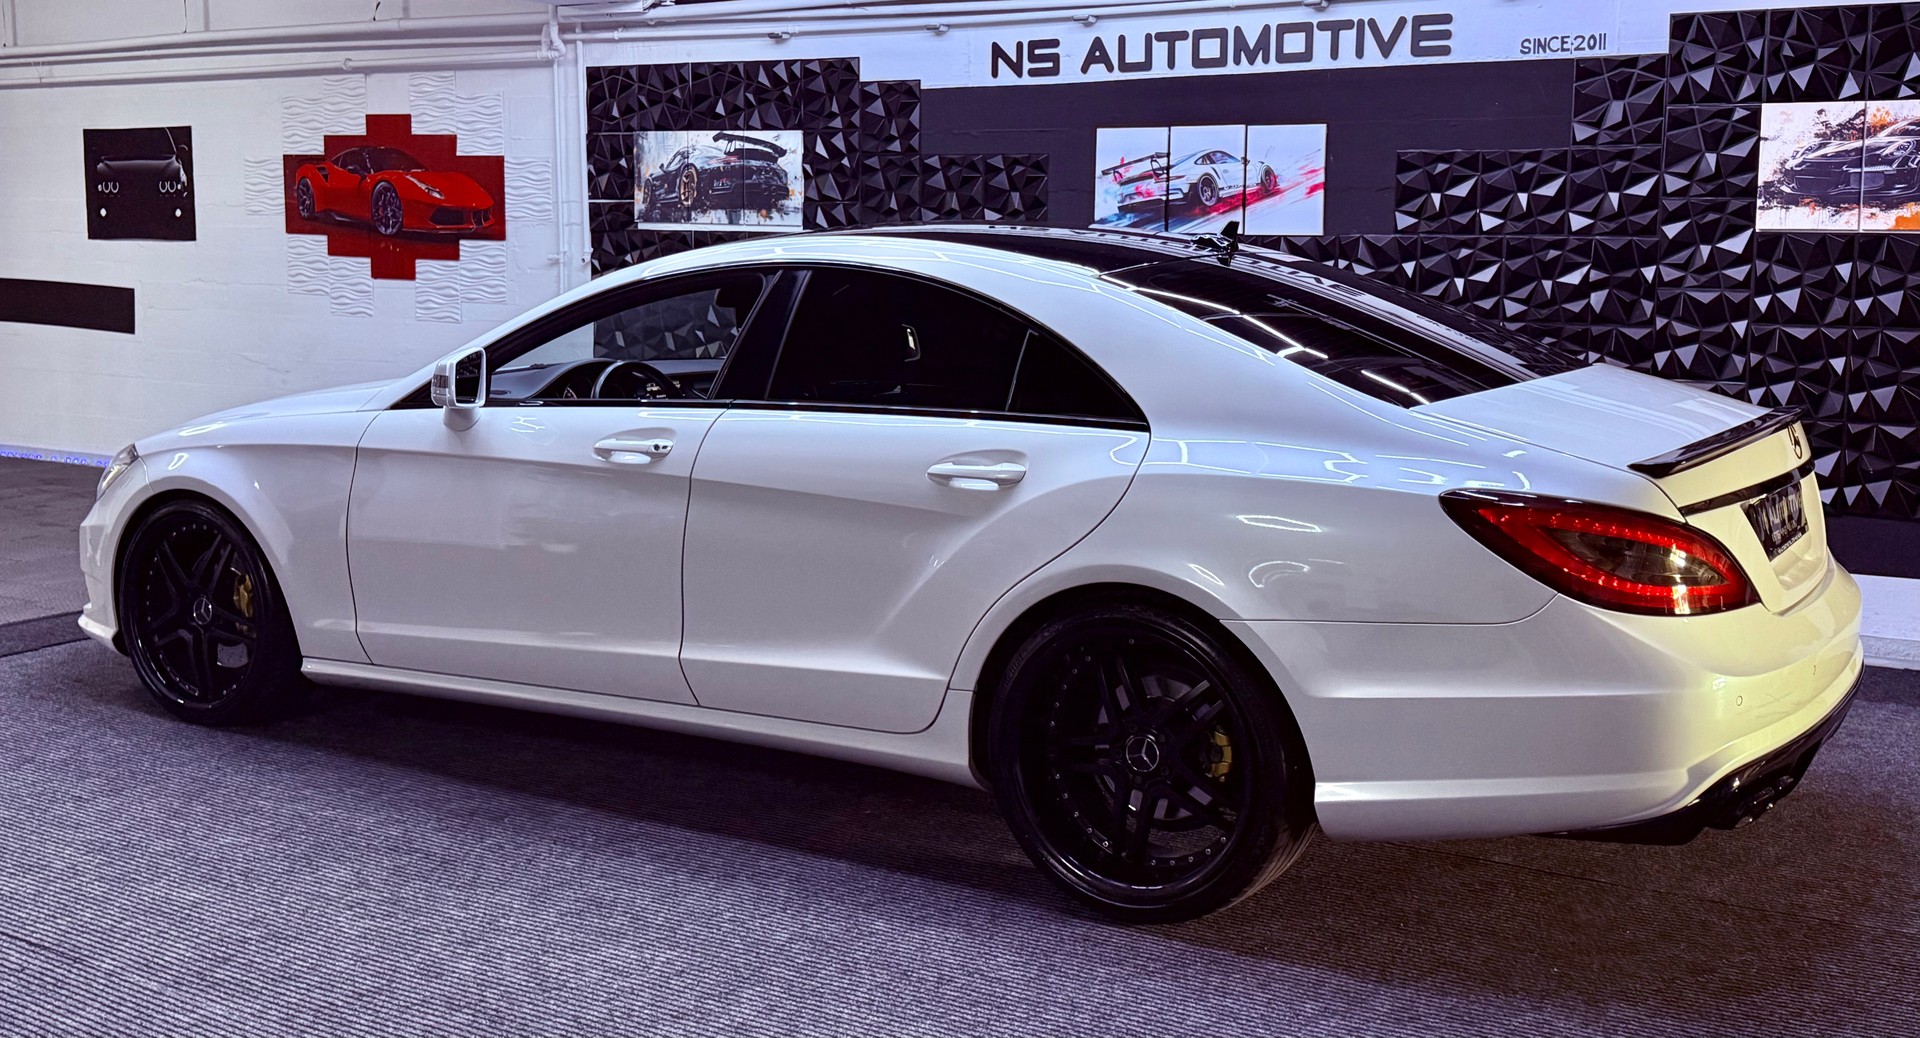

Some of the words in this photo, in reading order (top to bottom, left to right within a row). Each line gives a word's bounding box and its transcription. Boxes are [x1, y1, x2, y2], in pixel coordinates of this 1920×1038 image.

[991, 38, 1060, 79] NS
[1080, 13, 1453, 75] AUTOMOTIVE
[1520, 35, 1570, 55] SINCE
[1573, 32, 1607, 52] 2011
